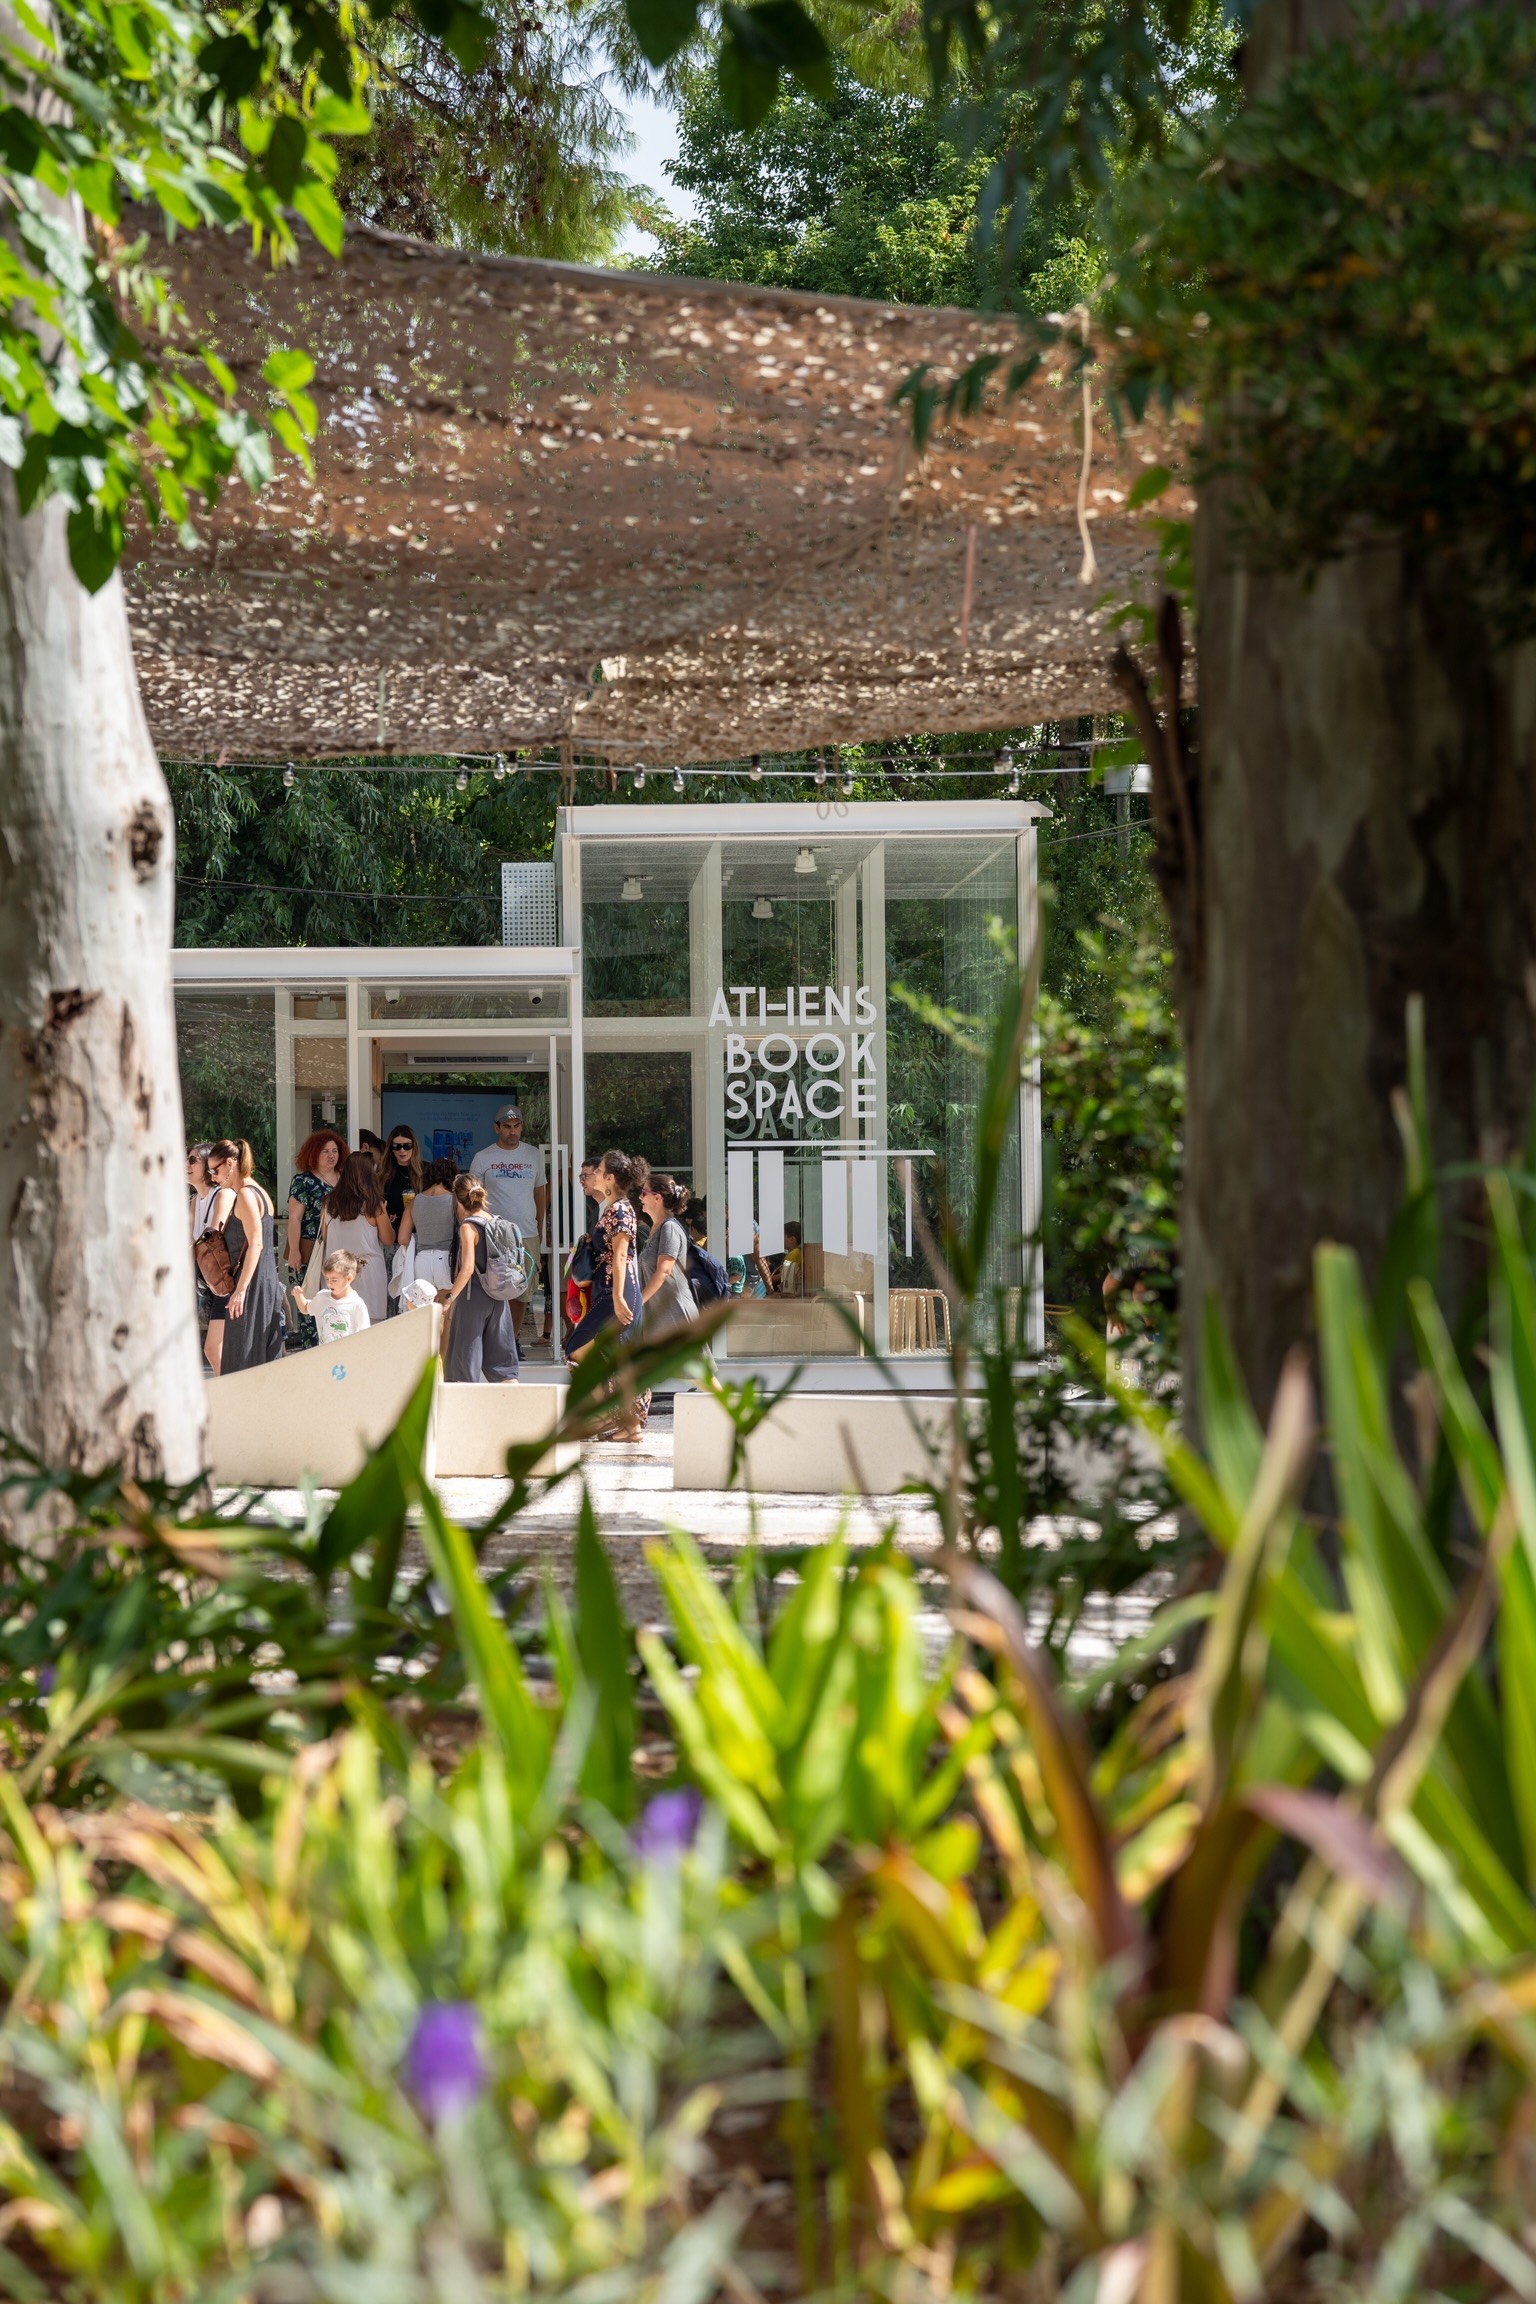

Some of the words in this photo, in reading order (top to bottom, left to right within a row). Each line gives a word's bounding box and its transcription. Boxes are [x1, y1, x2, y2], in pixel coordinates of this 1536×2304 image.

[708, 985, 878, 1027] ATHENS
[726, 1032, 877, 1073] BOOK
[726, 1078, 877, 1119] SPACE
